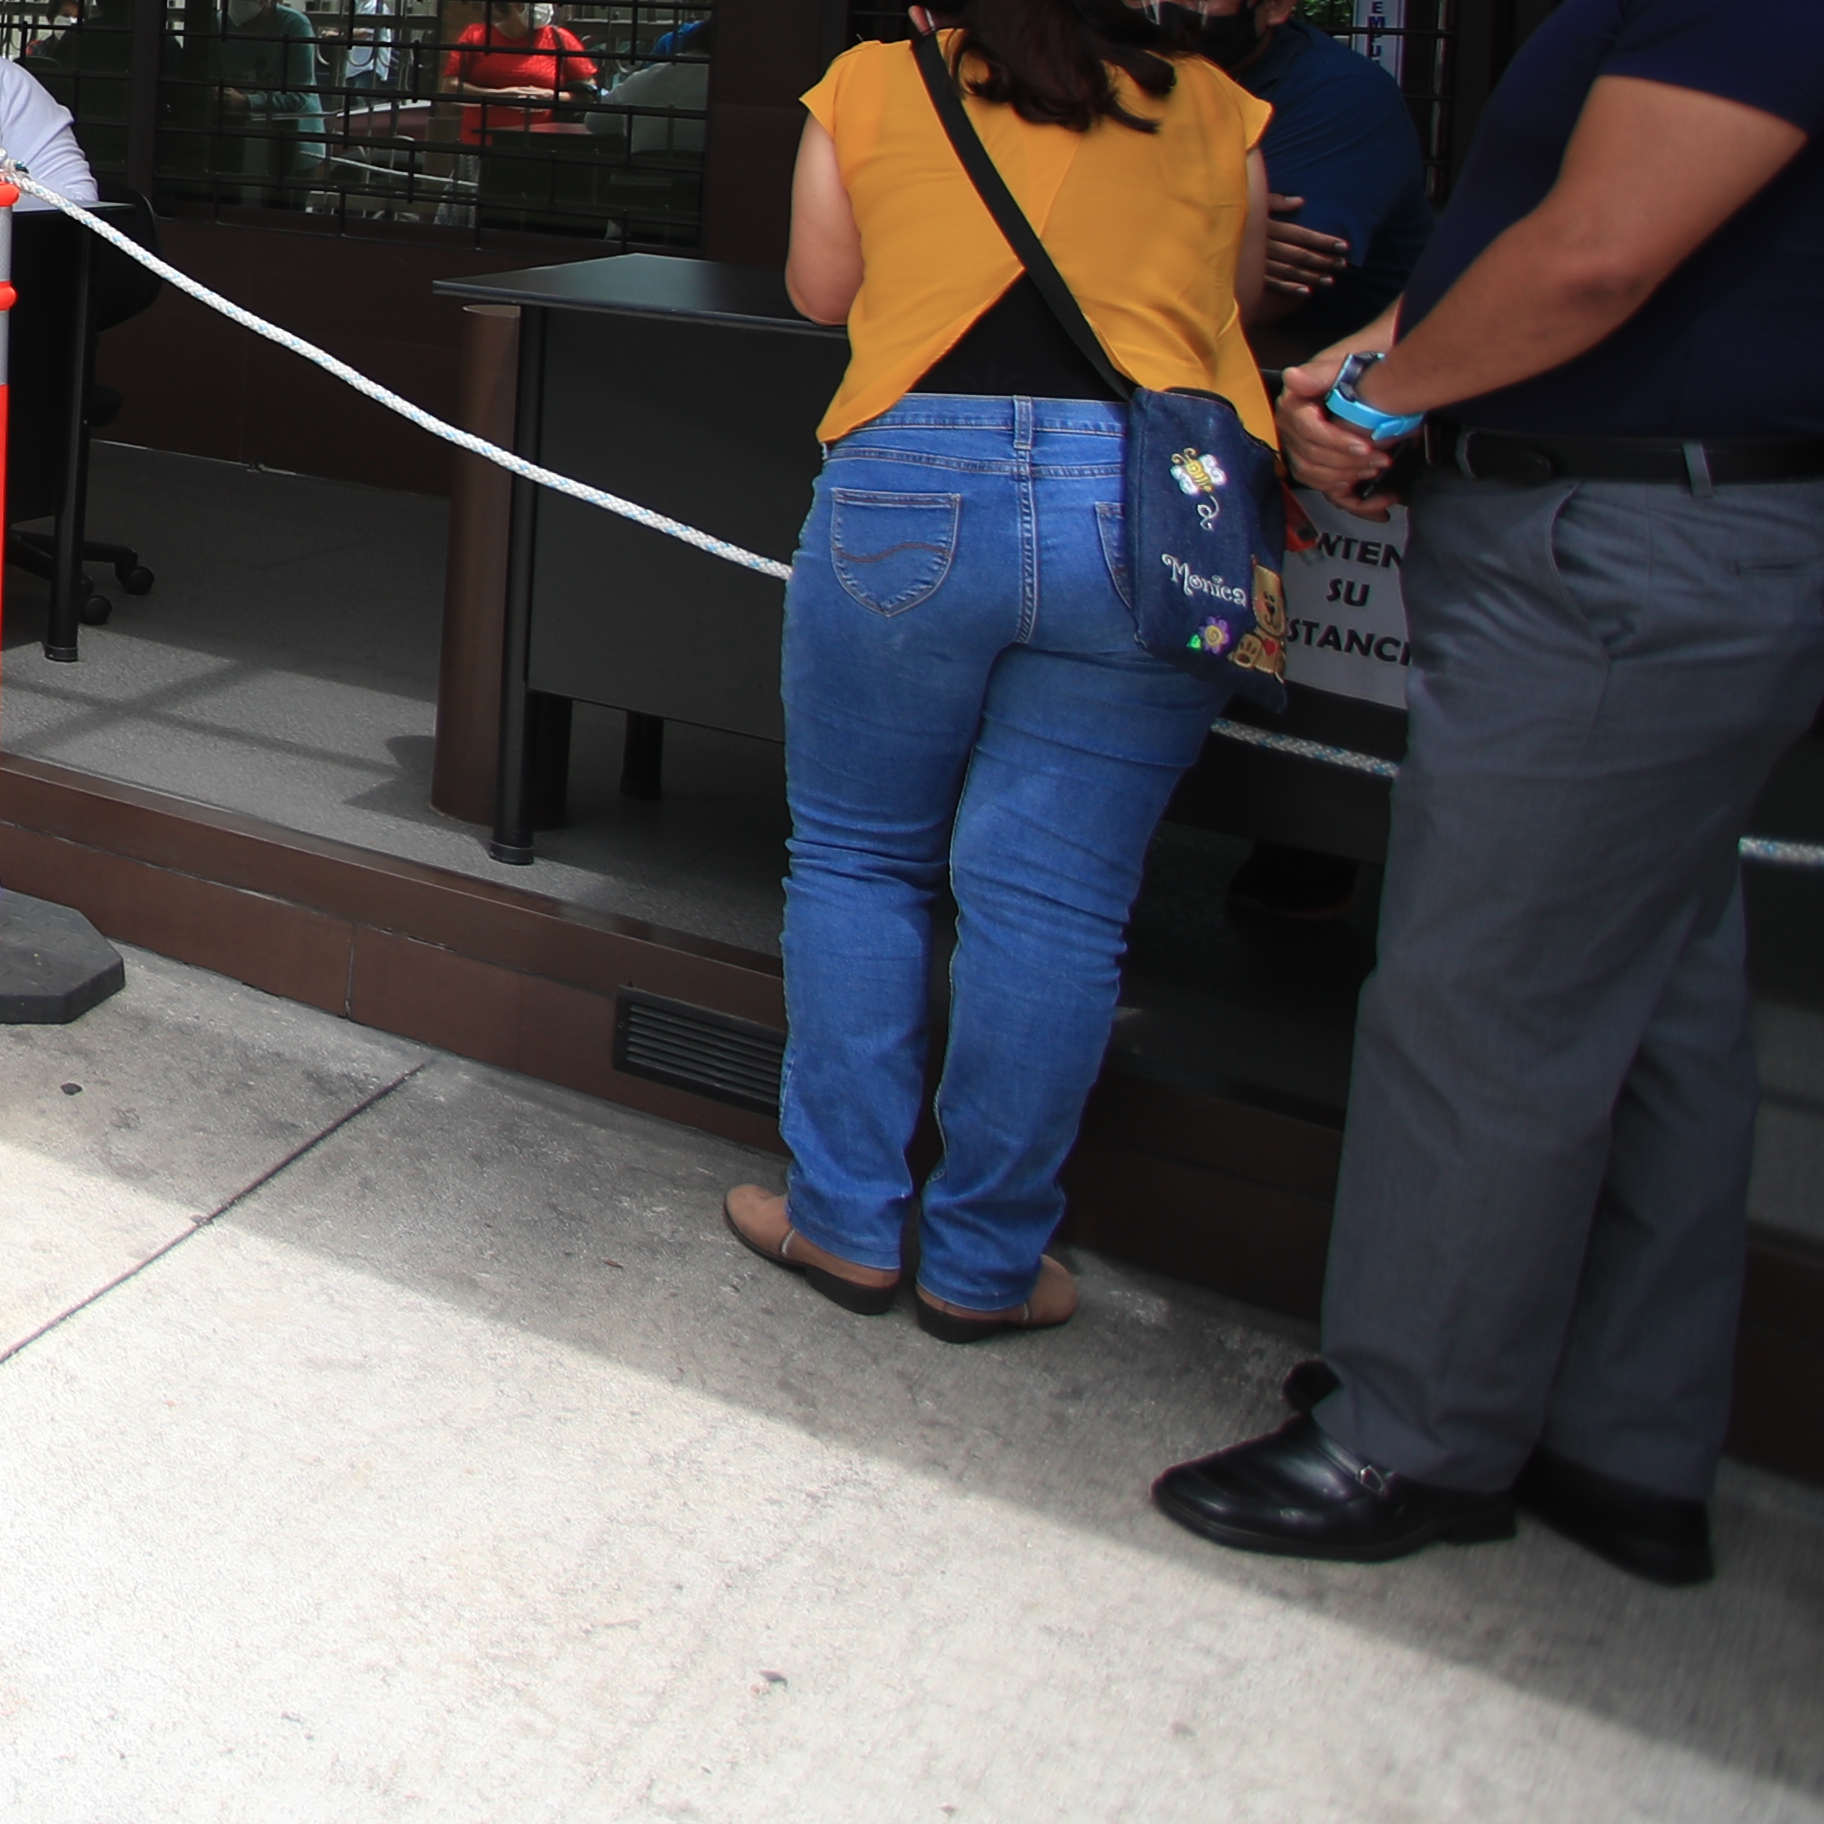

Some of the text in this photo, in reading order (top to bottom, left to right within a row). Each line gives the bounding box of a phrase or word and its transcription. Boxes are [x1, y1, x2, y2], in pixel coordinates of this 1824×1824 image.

[1161, 553, 1247, 608] Monica
[1325, 577, 1370, 607] SU
[1286, 617, 1411, 666] STANCI
